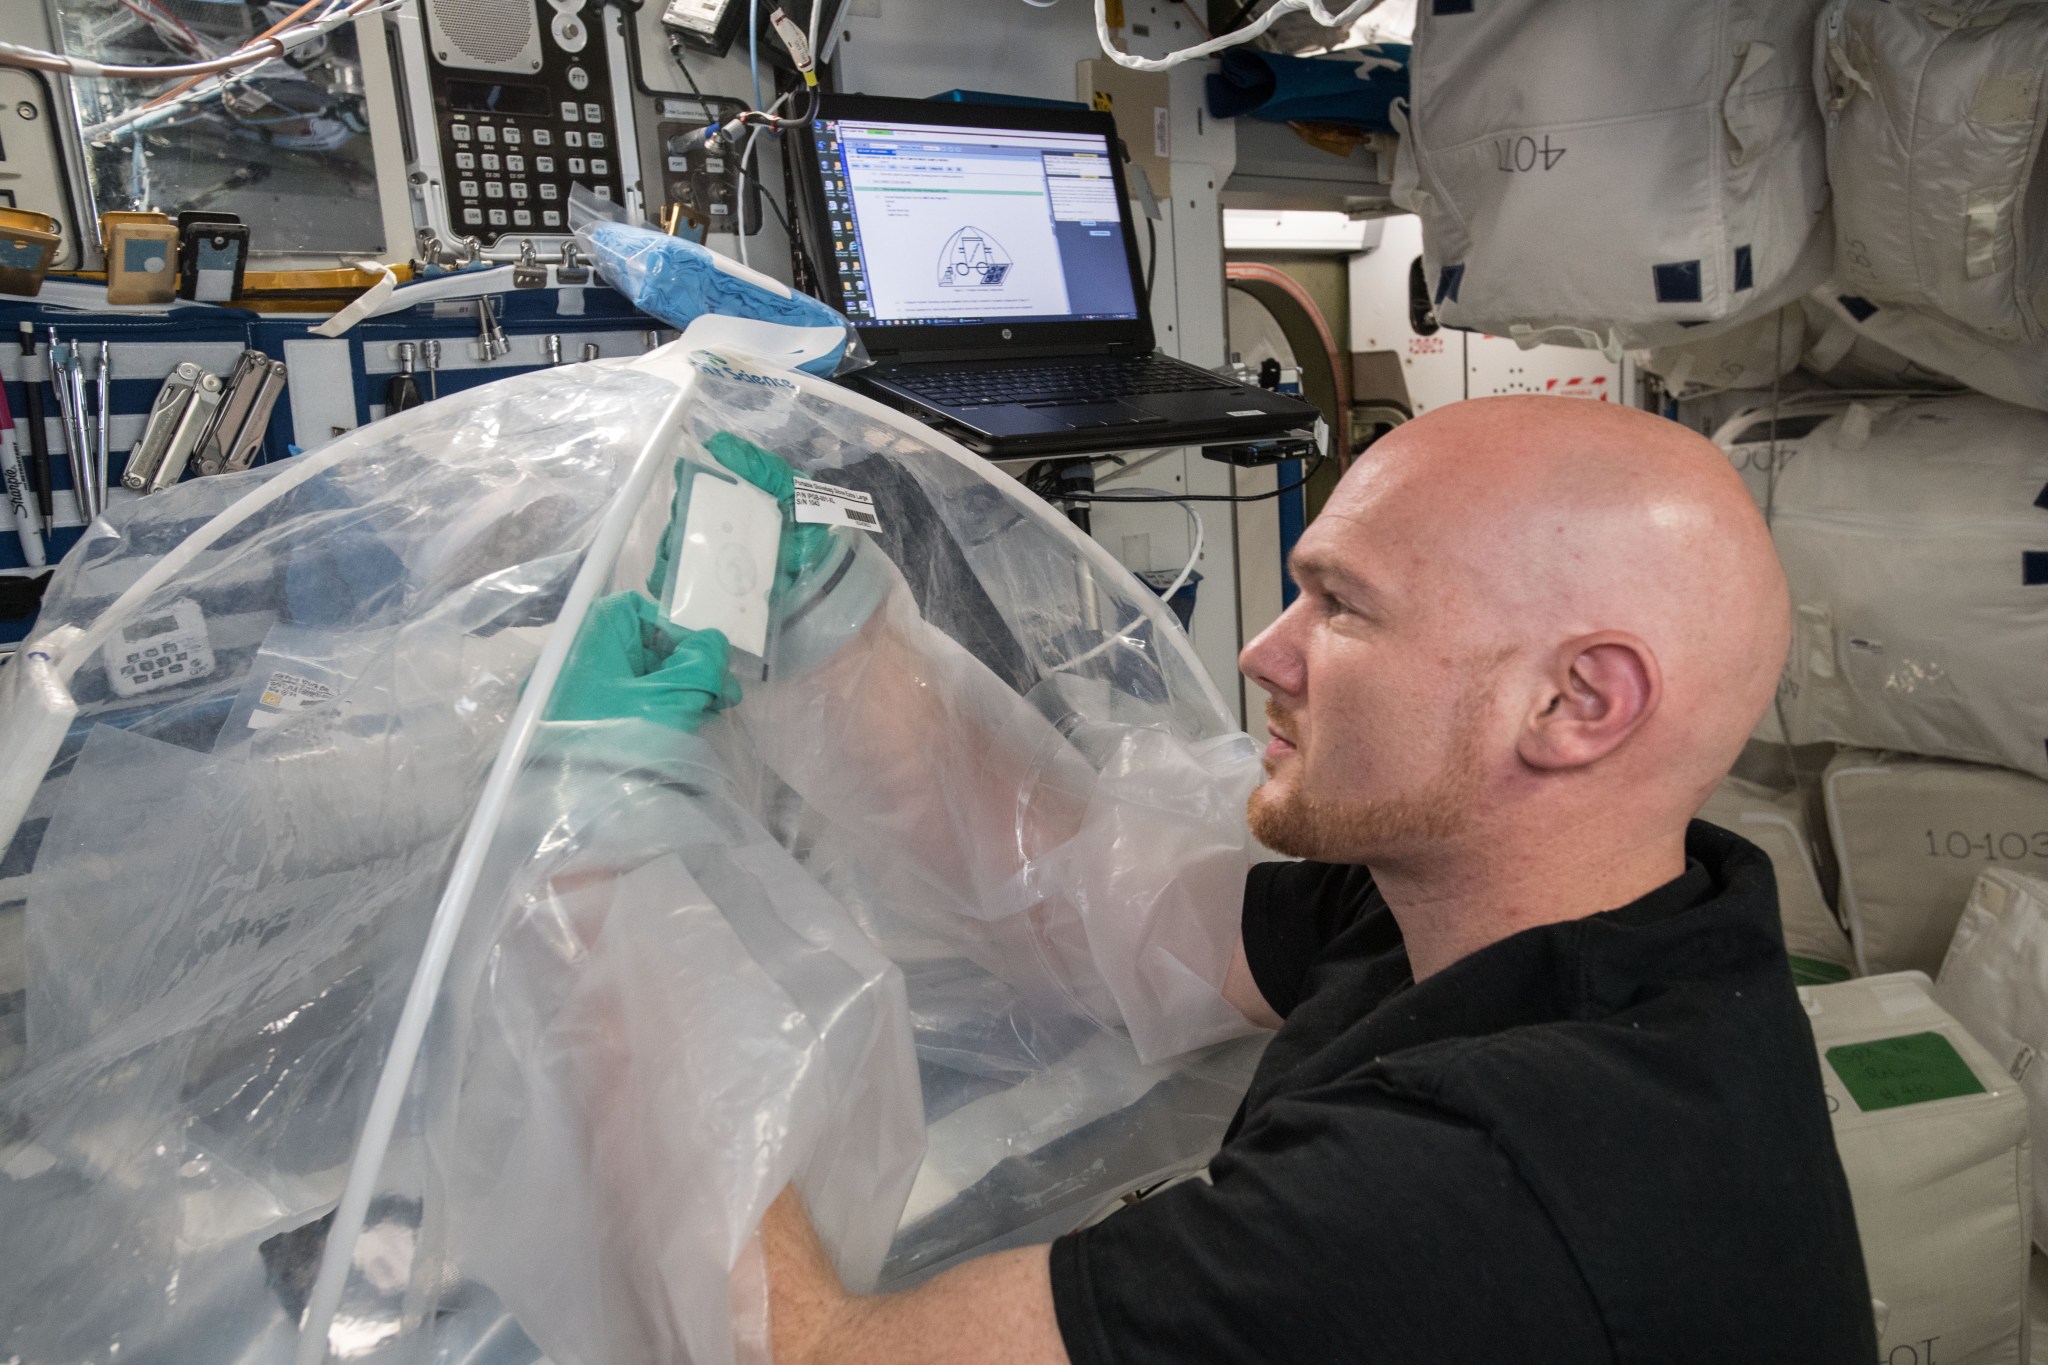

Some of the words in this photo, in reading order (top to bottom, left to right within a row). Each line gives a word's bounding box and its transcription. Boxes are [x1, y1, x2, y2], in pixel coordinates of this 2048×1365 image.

[571, 74, 586, 83] PTT
[722, 367, 796, 389] Science
[4, 465, 28, 519] Sharpie
[795, 480, 813, 488] Portable
[856, 493, 869, 501] Large
[796, 491, 806, 499] P/N
[796, 498, 808, 506] S/N
